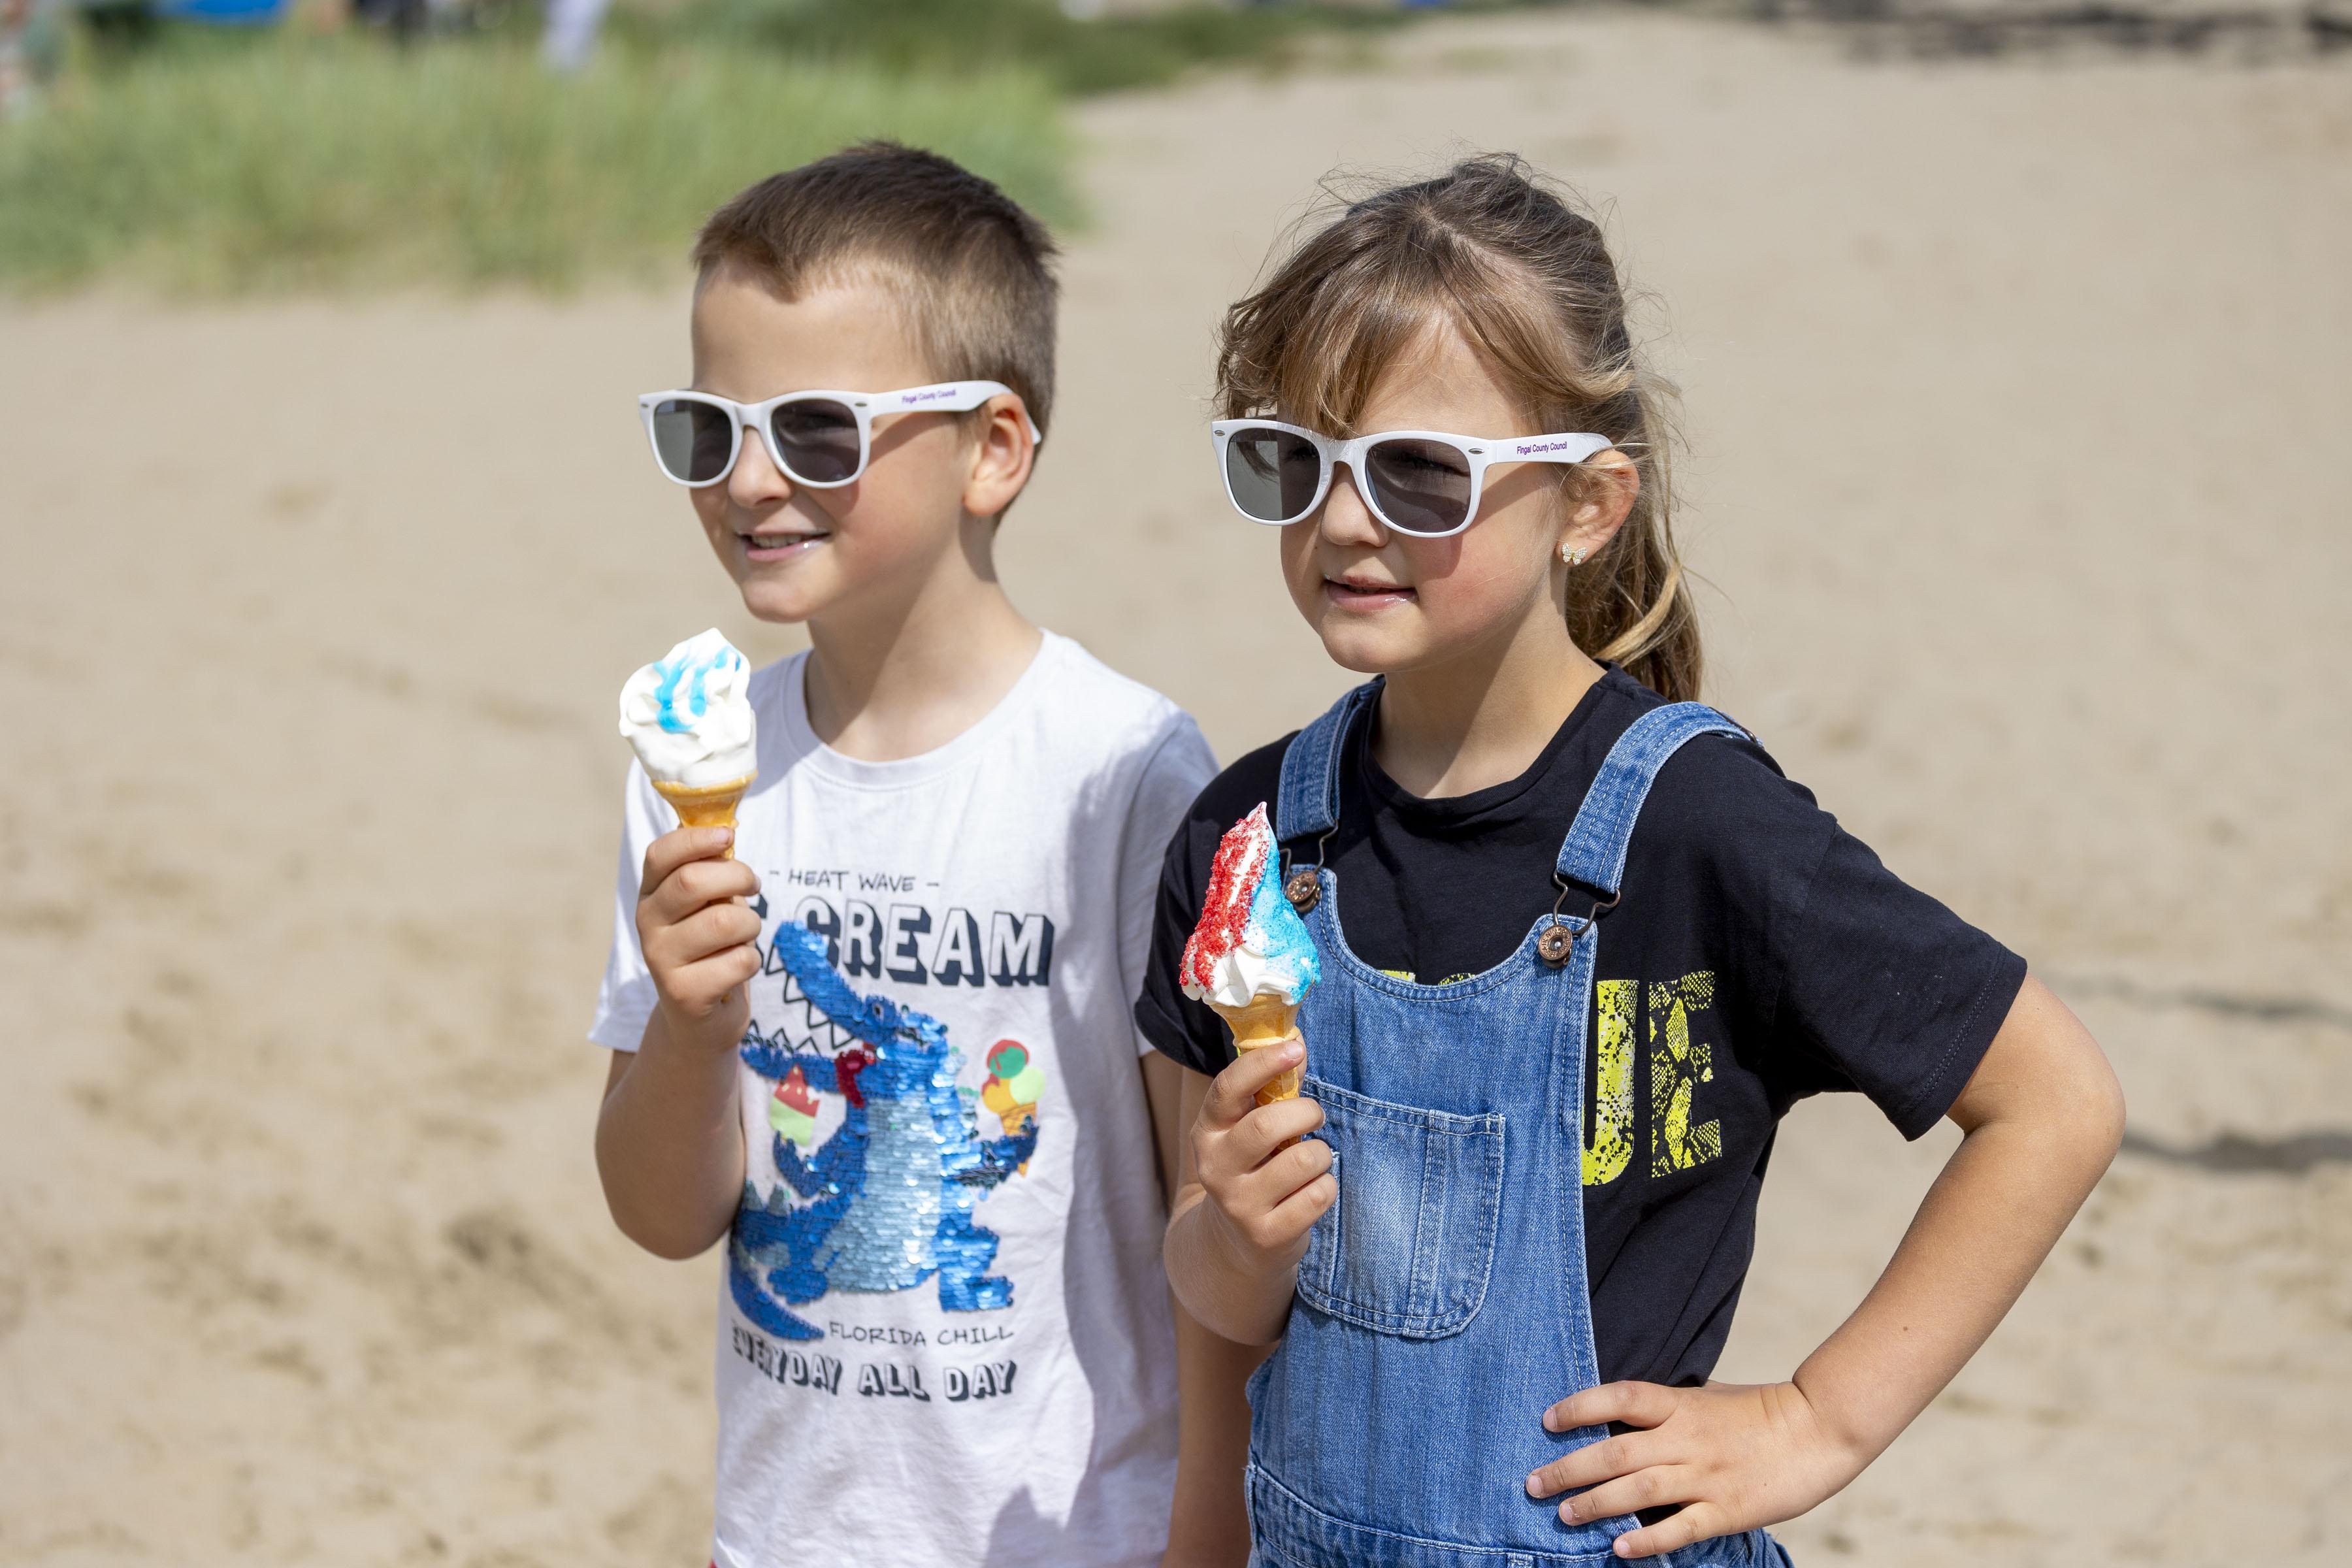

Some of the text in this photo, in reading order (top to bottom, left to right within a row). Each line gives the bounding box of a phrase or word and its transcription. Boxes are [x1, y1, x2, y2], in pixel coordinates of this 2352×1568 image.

[1517, 441, 1567, 455] Fingal County Council
[788, 868, 916, 892] HEAT WAVE
[829, 1320, 1014, 1347] FLORIDA CHILL
[858, 1364, 930, 1402] ALL
[943, 1360, 1017, 1402] DAY
